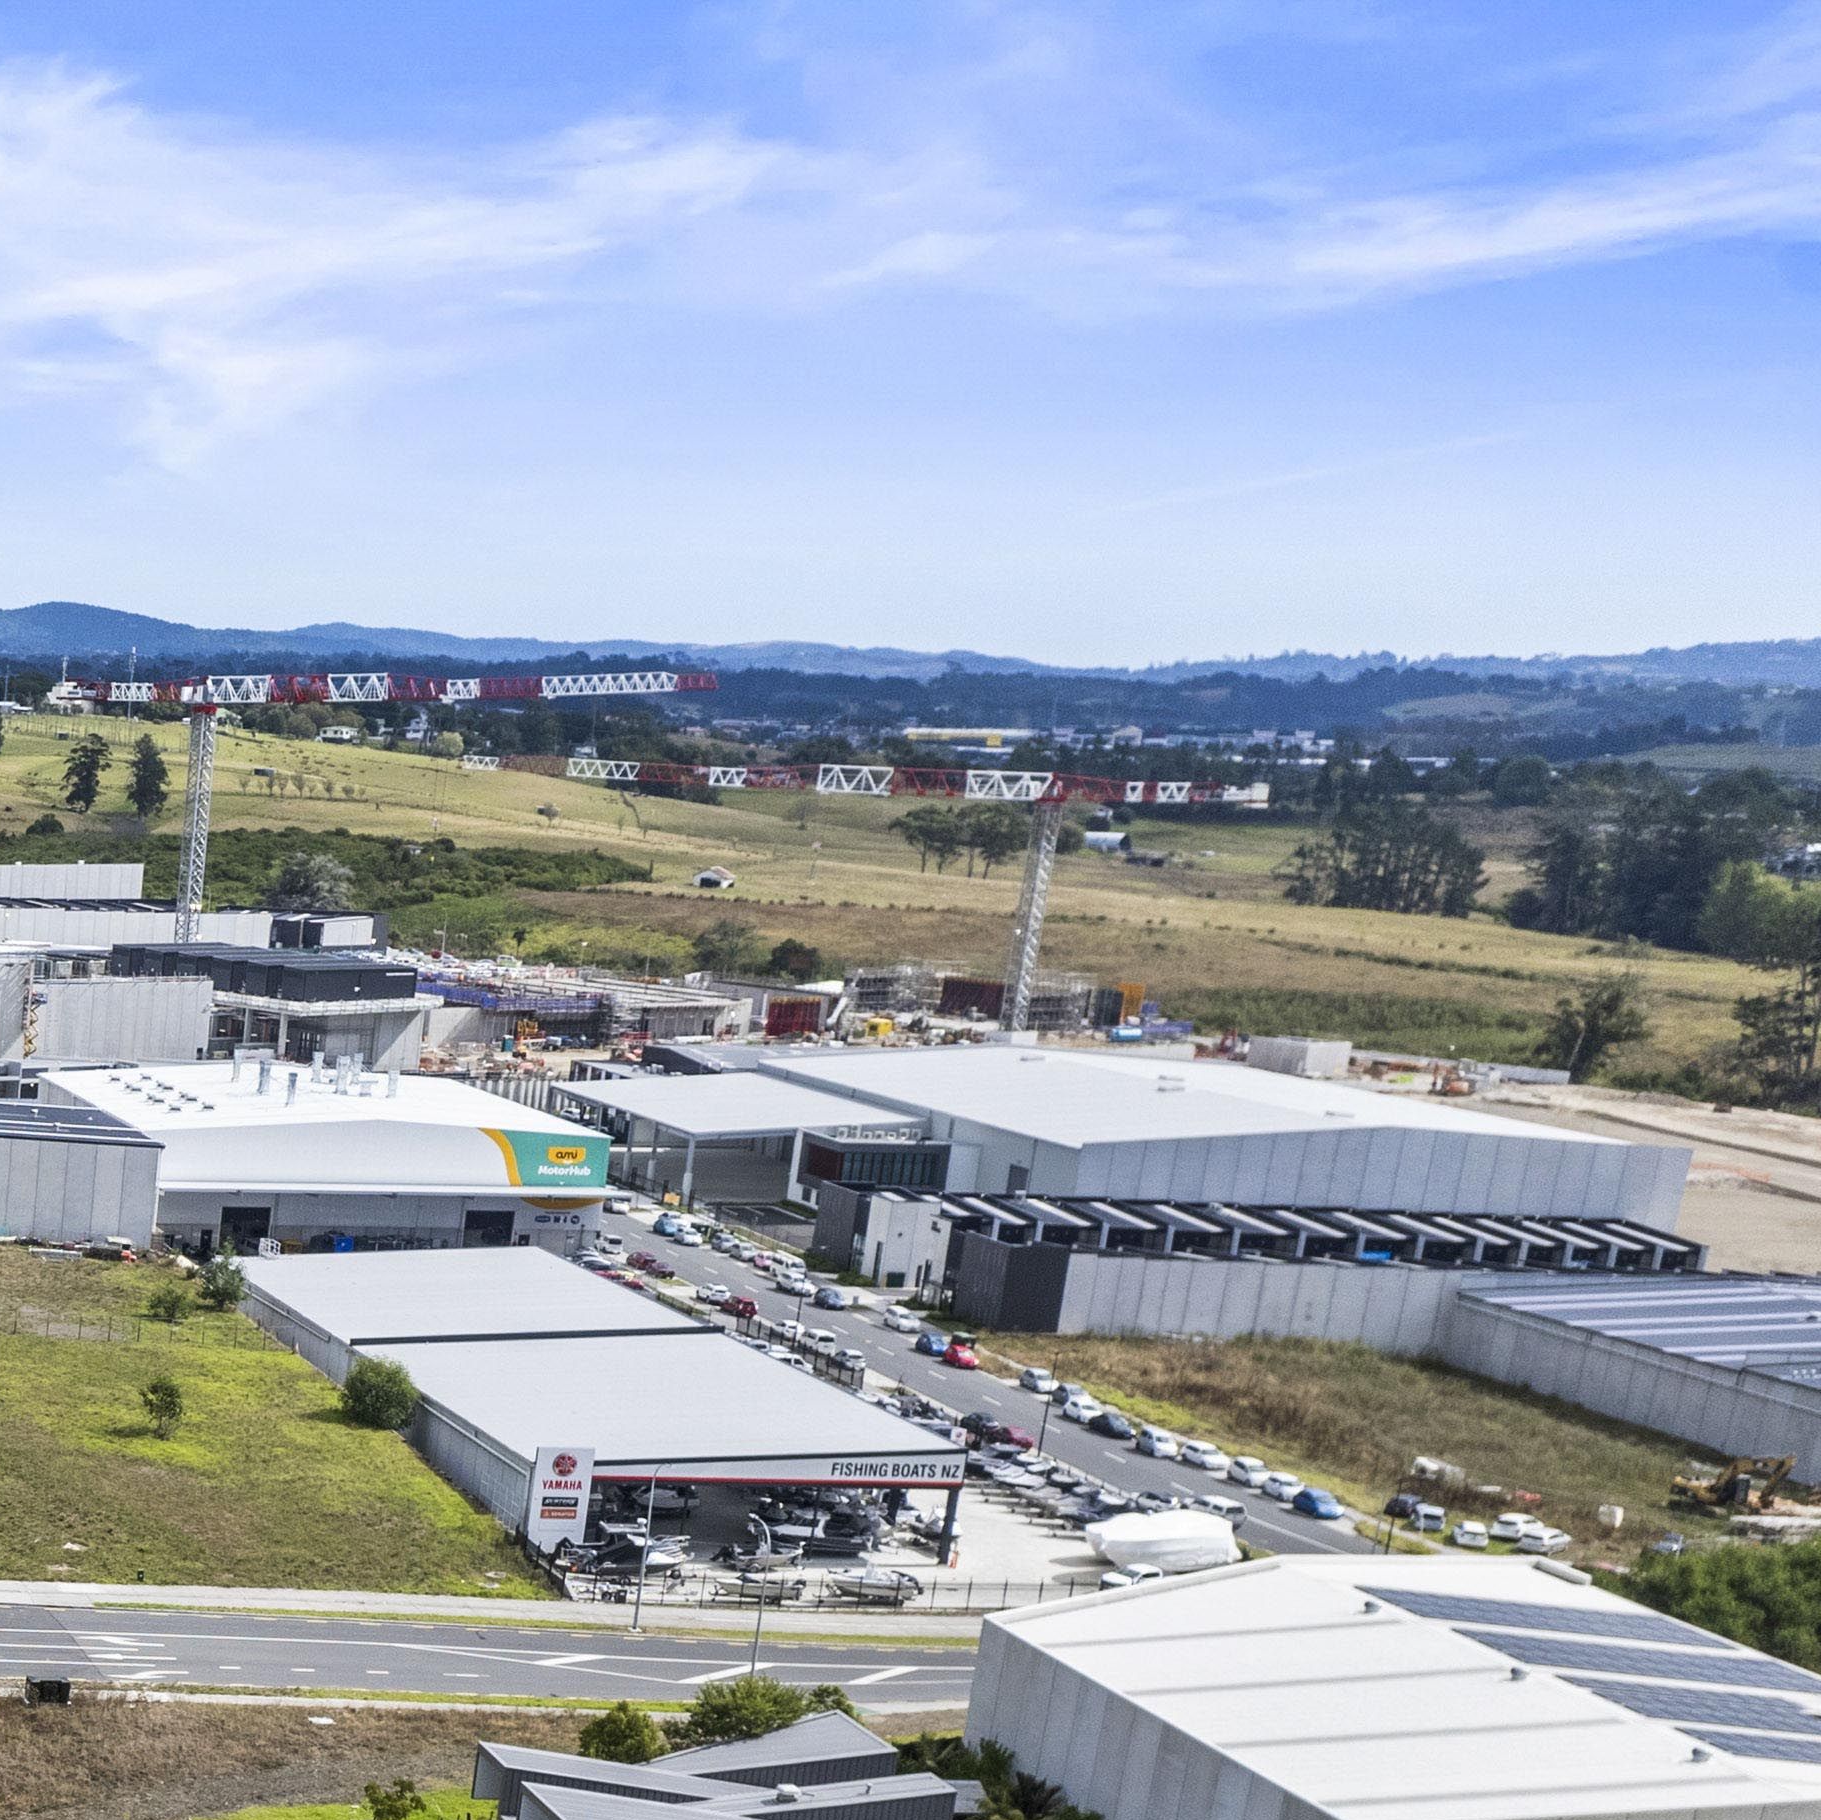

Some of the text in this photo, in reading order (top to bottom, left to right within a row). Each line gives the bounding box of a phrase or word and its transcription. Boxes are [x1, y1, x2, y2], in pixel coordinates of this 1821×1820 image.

[538, 1165, 592, 1176] MotorHub
[830, 1462, 961, 1479] FISHING BOATS NZ
[542, 1480, 582, 1491] YAMAHA
